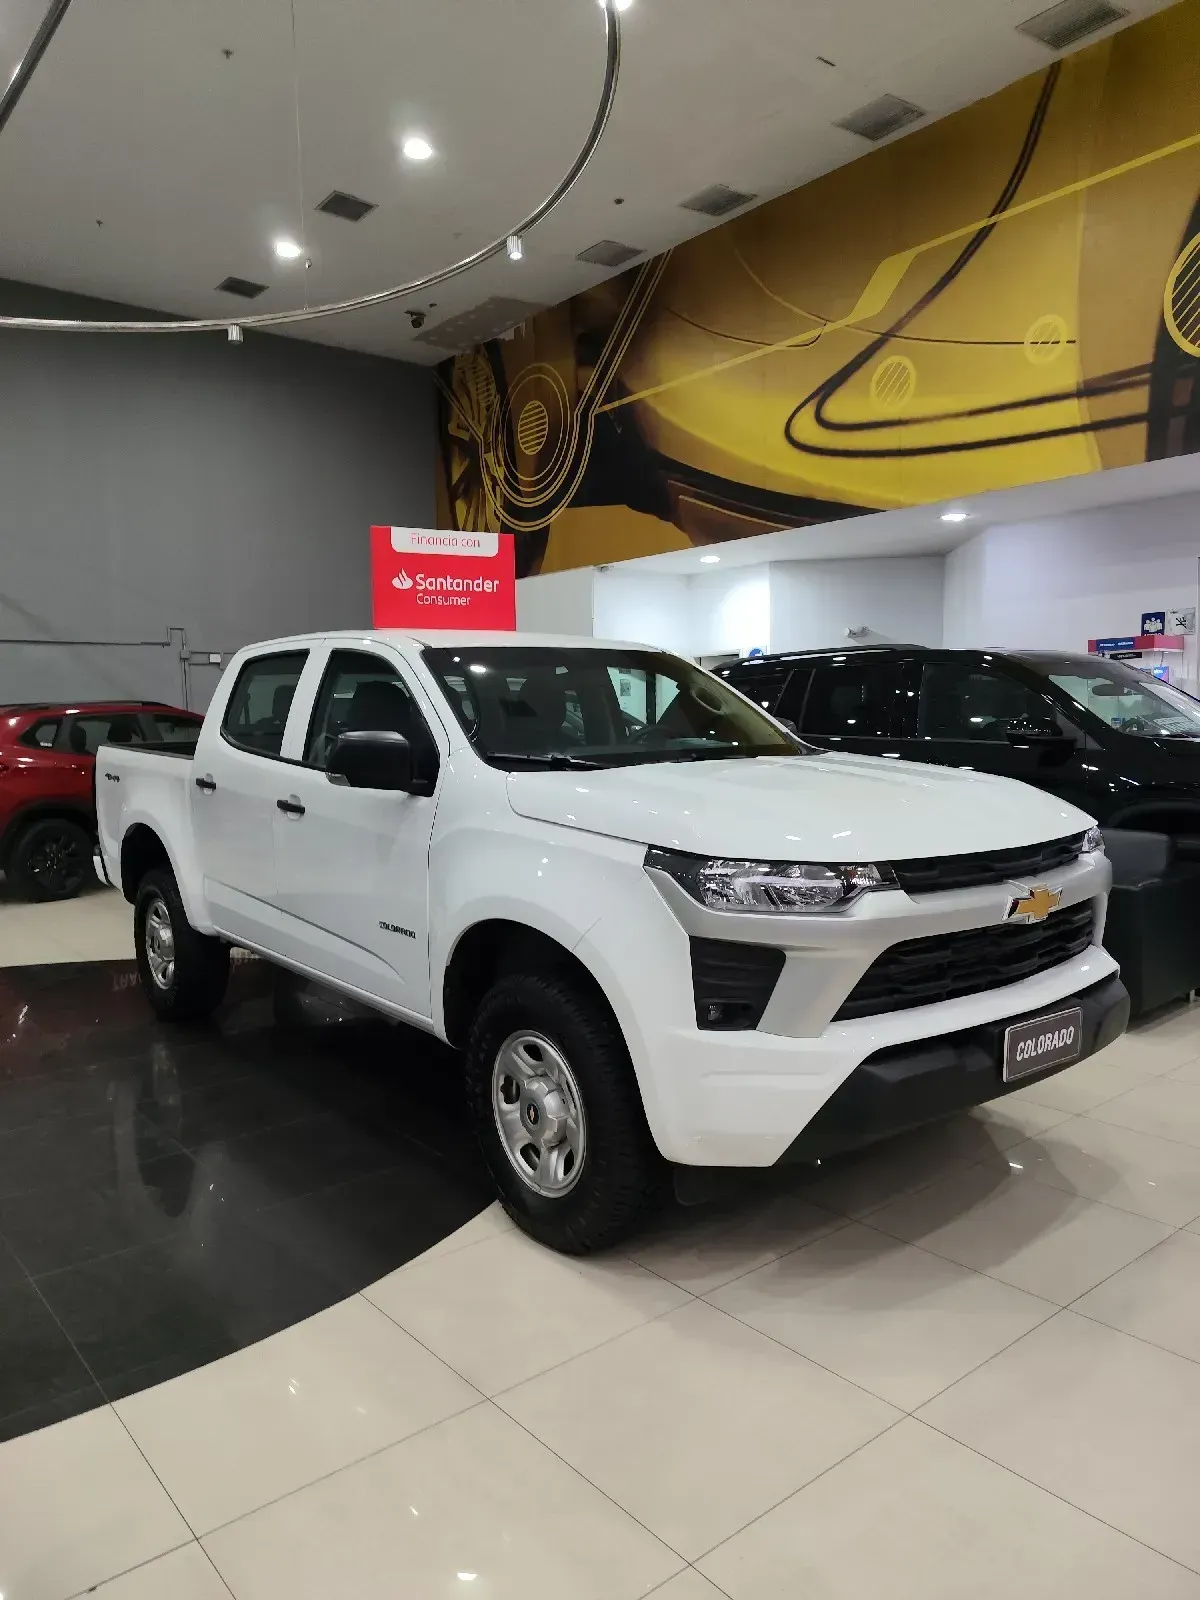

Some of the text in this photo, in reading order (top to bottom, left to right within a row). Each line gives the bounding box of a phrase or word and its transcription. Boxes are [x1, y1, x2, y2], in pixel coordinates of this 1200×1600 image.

[411, 532, 481, 548] Financia con
[415, 574, 499, 593] Santander
[416, 593, 471, 606] Consumer
[1016, 1025, 1075, 1062] COLORADO
